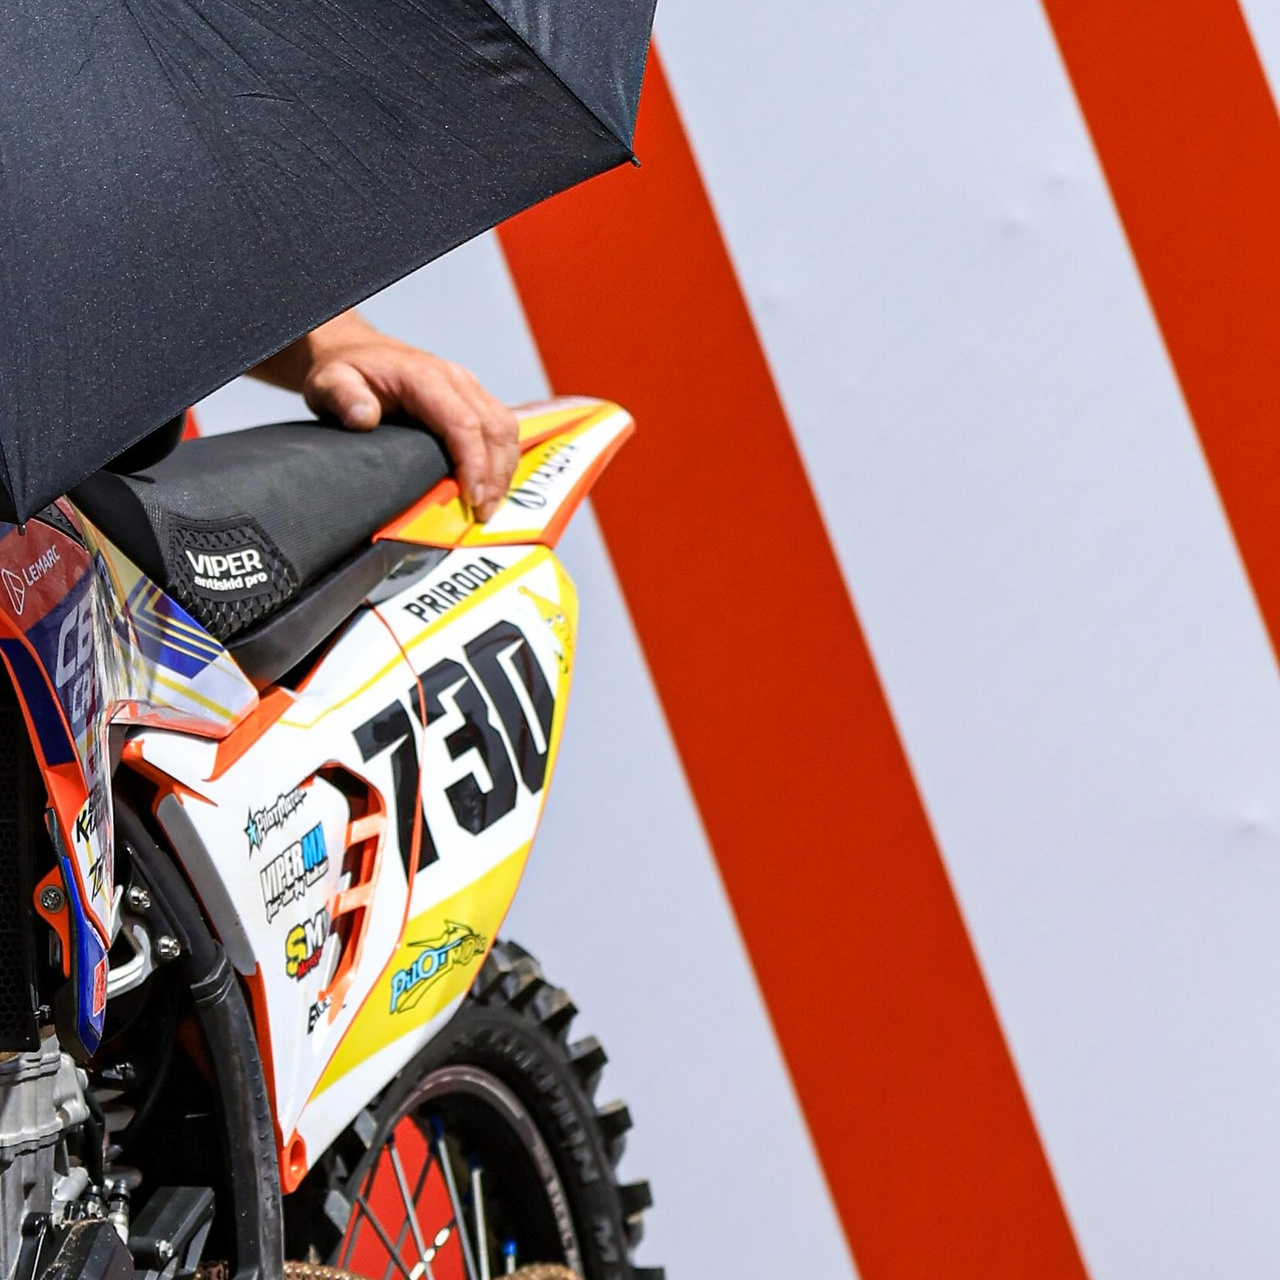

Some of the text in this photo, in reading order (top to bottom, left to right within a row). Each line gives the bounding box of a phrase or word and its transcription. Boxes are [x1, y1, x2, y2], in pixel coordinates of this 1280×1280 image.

[22, 544, 61, 587] LEMARC
[185, 548, 263, 578] VIPER
[194, 572, 268, 591] antiskid pro
[402, 556, 507, 624] PRIRODA
[352, 619, 557, 885] 730
